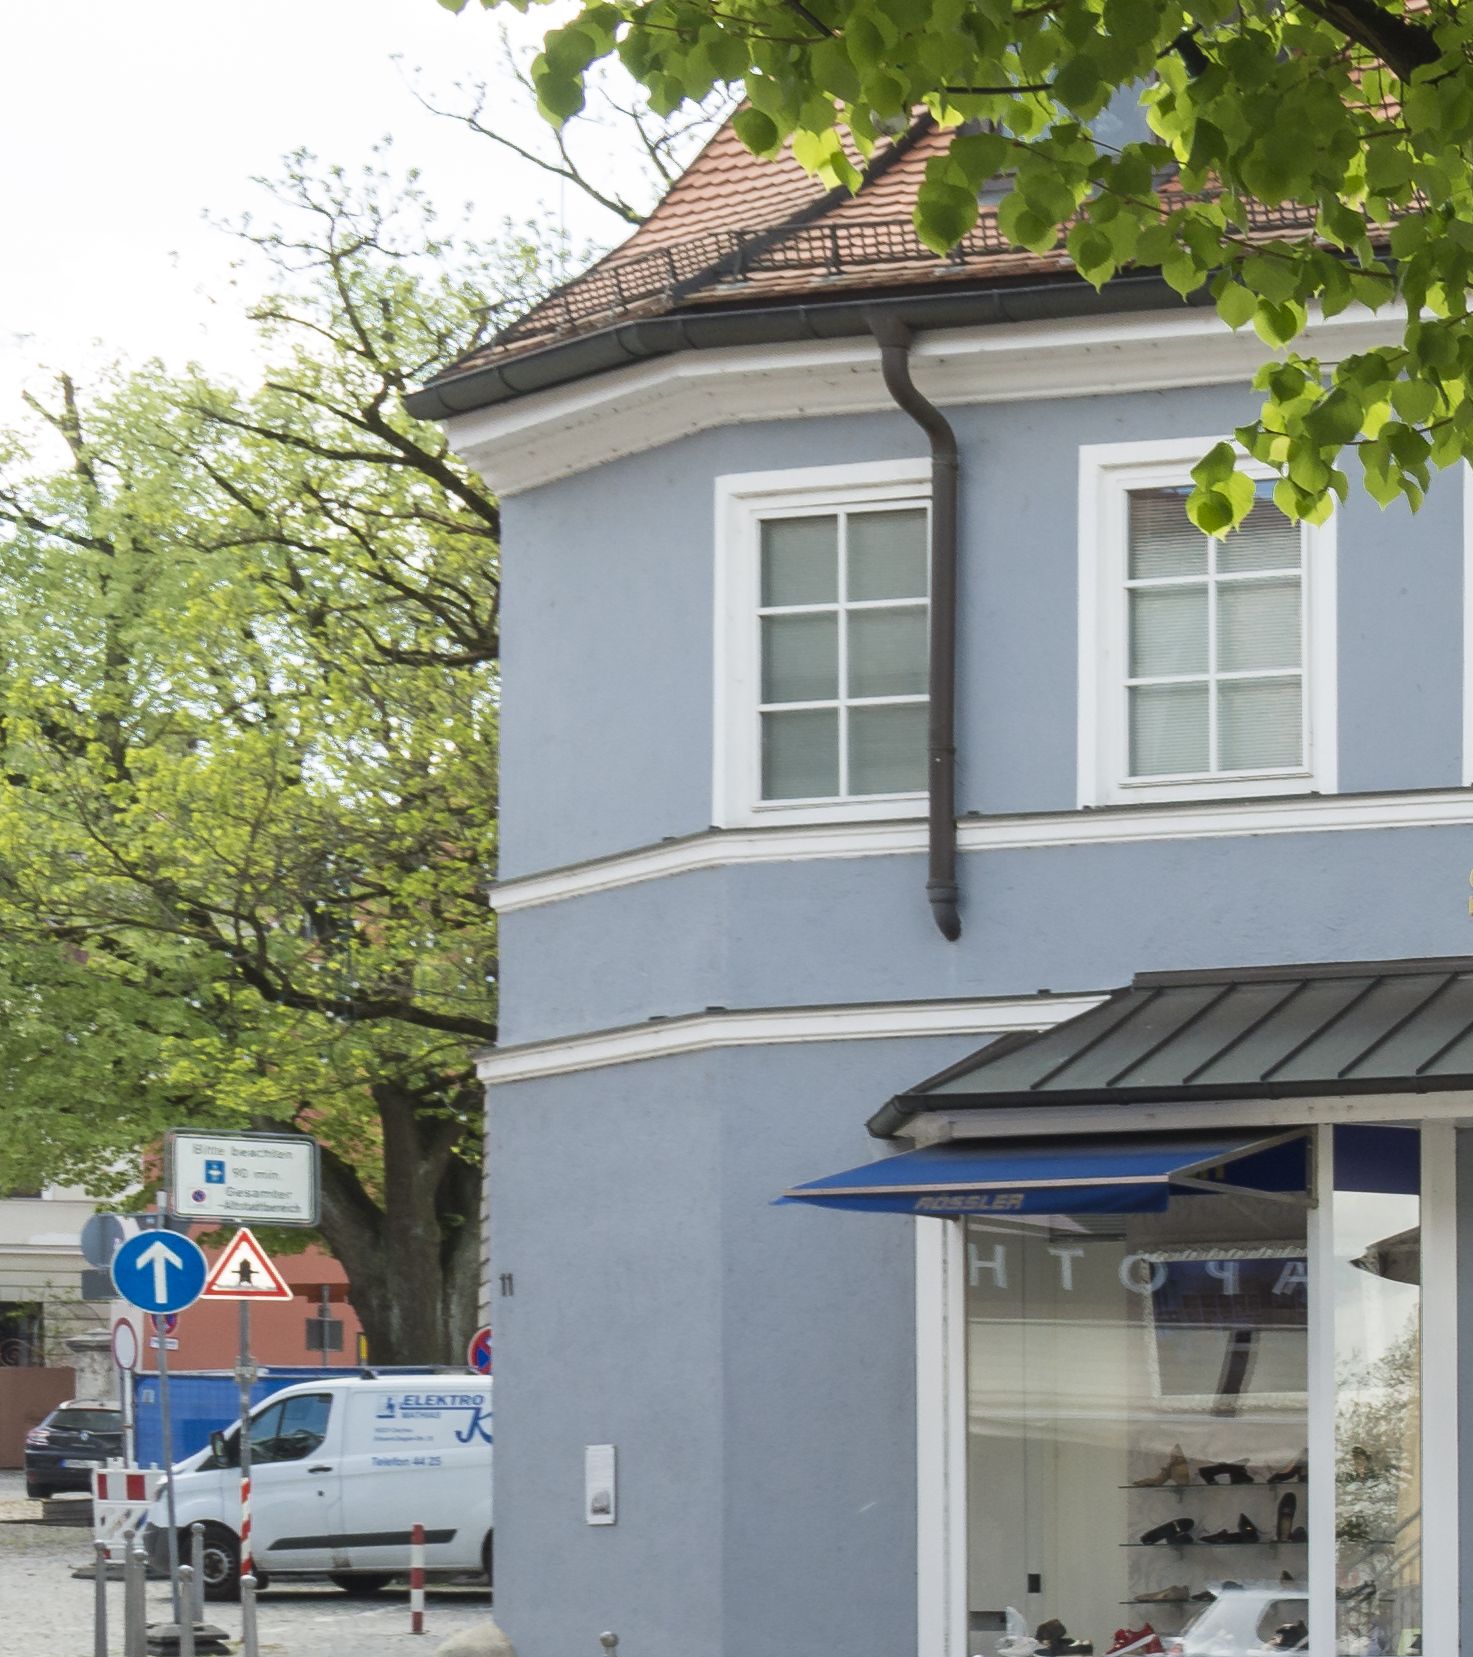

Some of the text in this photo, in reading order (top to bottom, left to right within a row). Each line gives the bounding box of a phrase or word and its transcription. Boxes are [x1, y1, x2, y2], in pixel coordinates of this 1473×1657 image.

[192, 1143, 293, 1159] Bitte beachten
[232, 1167, 249, 1179] 90
[225, 1186, 293, 1199] Gesamter
[912, 1193, 1025, 1211] RÖSSLER
[500, 1273, 514, 1297] 11
[402, 1394, 485, 1406] ELEKTRO
